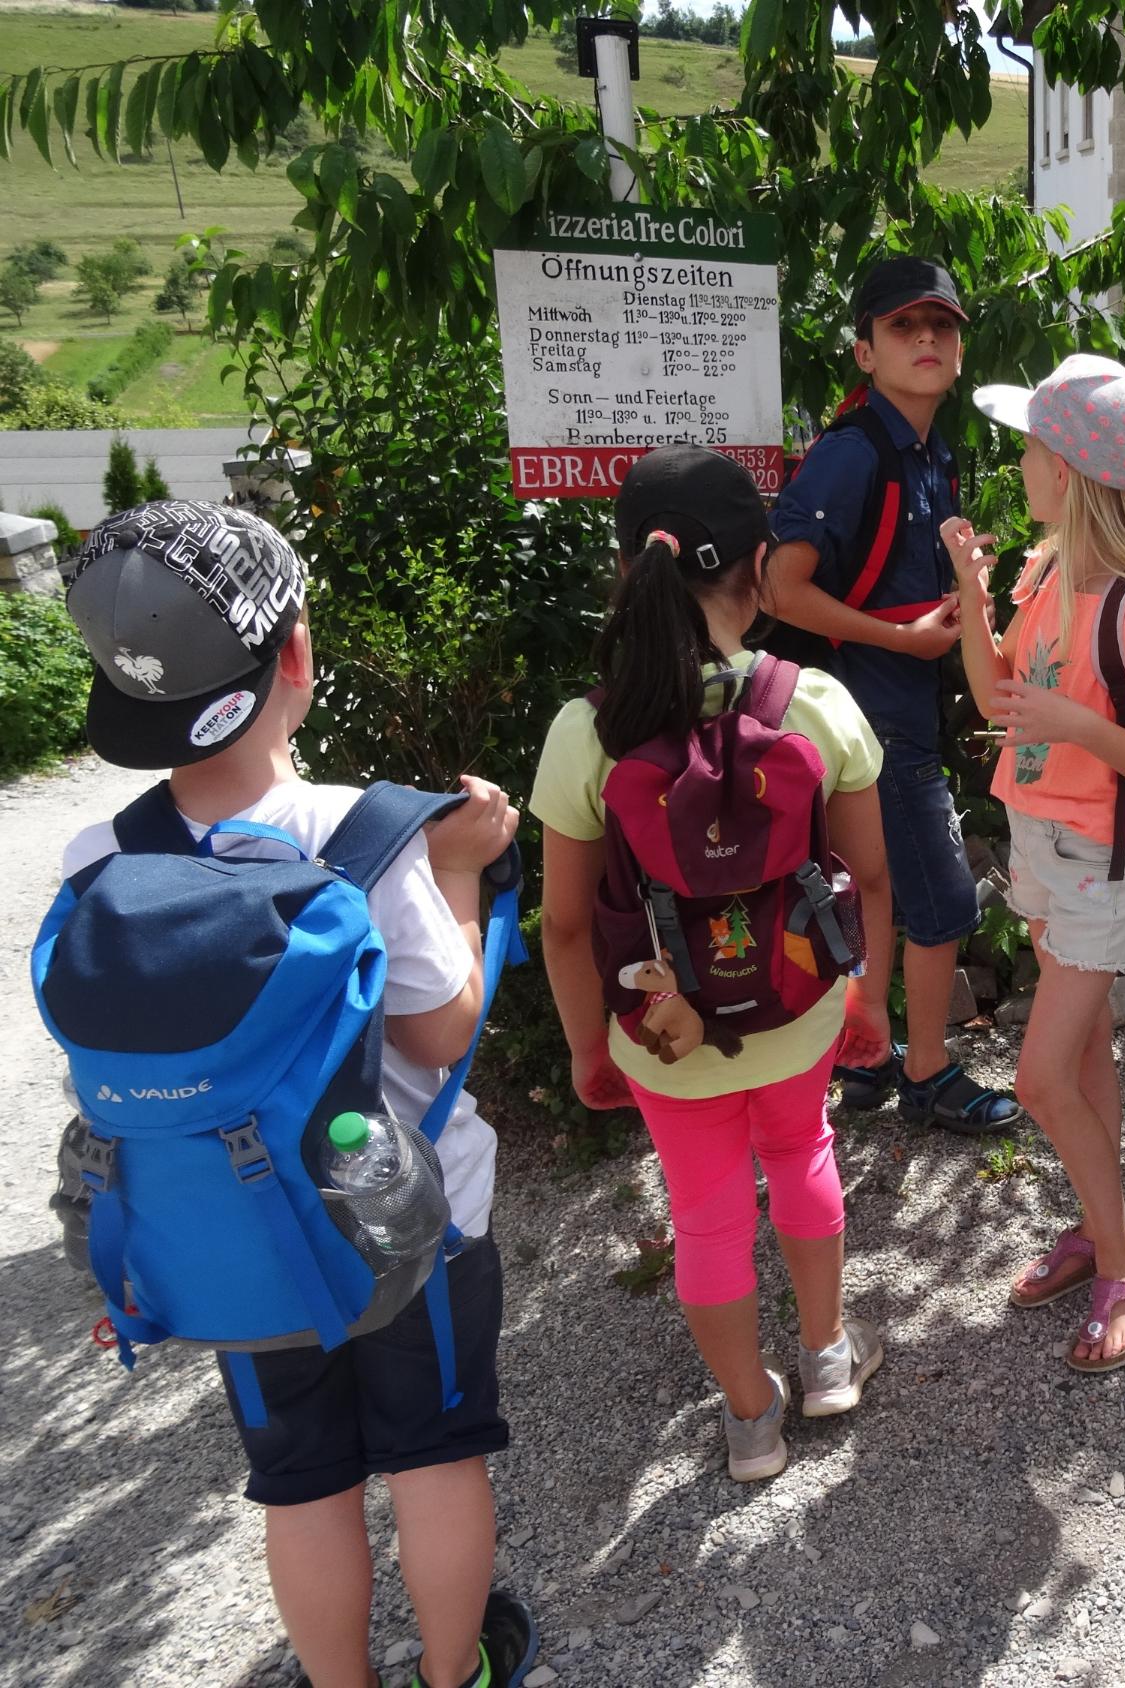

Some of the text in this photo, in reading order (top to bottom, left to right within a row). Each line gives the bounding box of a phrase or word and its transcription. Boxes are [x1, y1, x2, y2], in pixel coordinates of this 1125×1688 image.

[535, 211, 637, 241] izzeria
[679, 216, 746, 249] Colori
[541, 253, 734, 291] Öffnungszeiten
[624, 291, 686, 311] Dienstag
[529, 327, 620, 349] Donnerstag
[530, 342, 587, 363] Freitag
[532, 357, 602, 379] Samstag
[616, 390, 643, 405] und
[645, 389, 717, 411] Feiertage
[705, 428, 727, 443] 25
[517, 455, 642, 489] EBRAC
[705, 844, 740, 859] deuter
[128, 1077, 214, 1100] VAUDE
